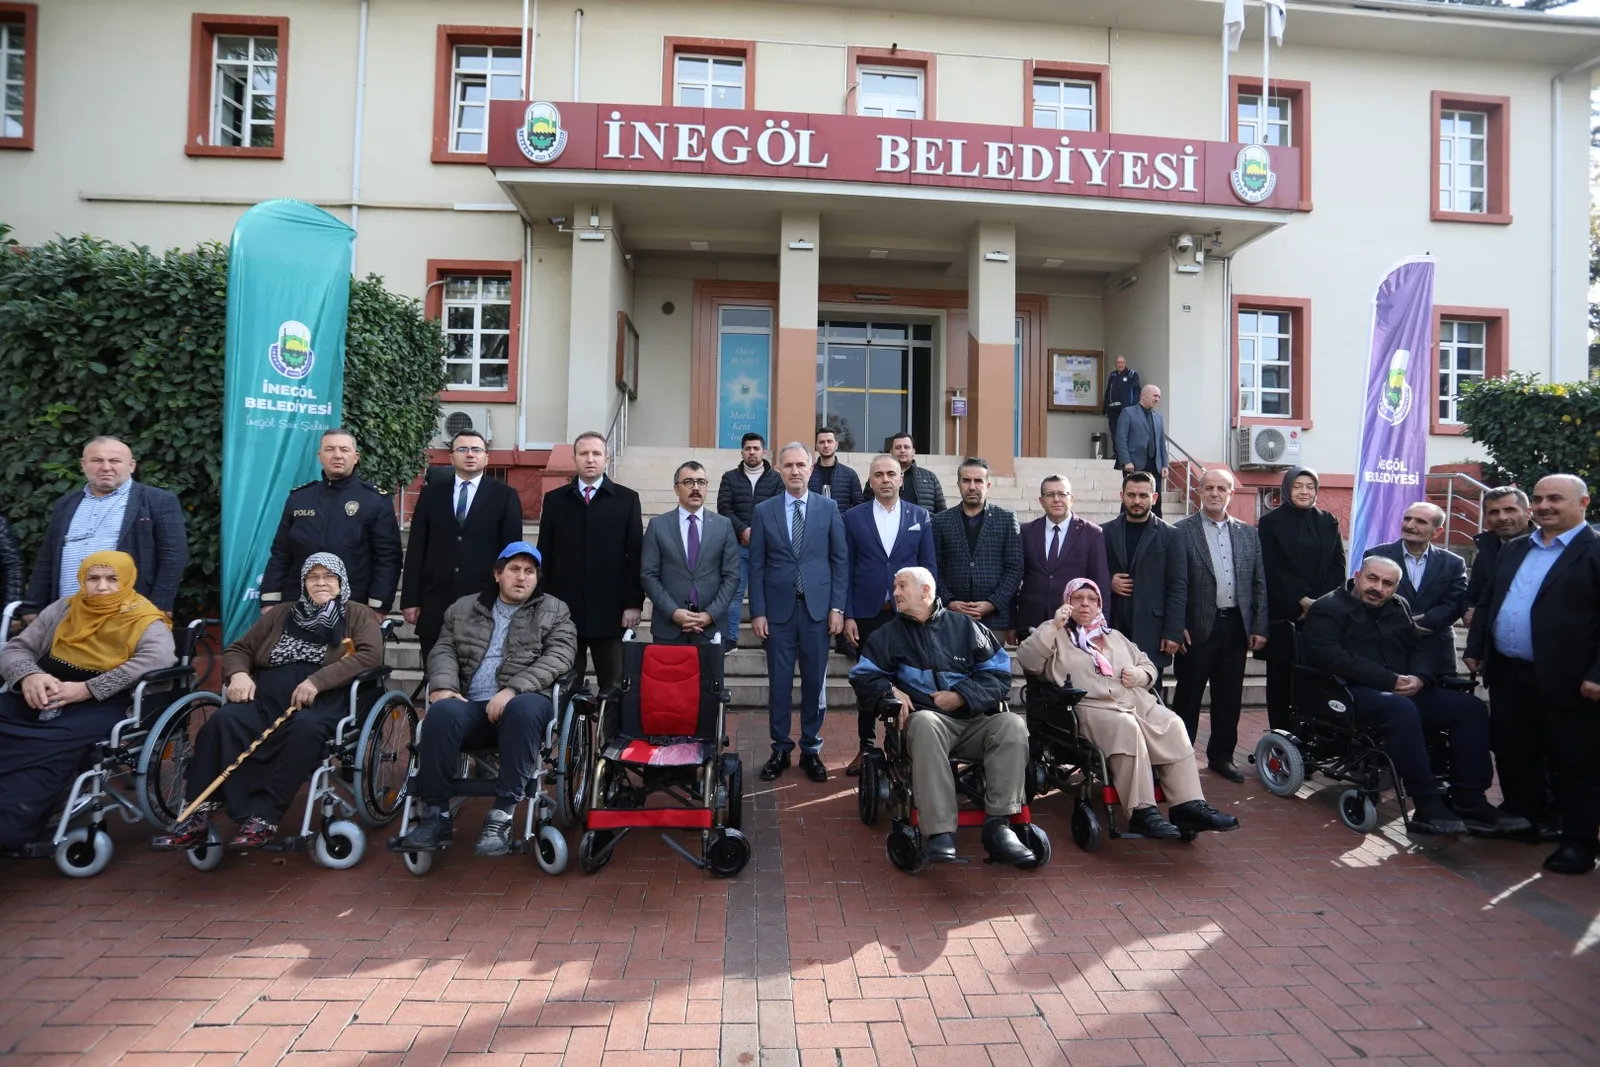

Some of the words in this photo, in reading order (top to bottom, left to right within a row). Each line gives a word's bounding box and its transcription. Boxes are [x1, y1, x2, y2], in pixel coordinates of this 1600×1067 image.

[603, 111, 829, 168] İNEGÖL
[876, 134, 1198, 192] BELEDİYESİ
[262, 379, 317, 399] İNEGÖL
[244, 397, 332, 415] BELEDİYESİ
